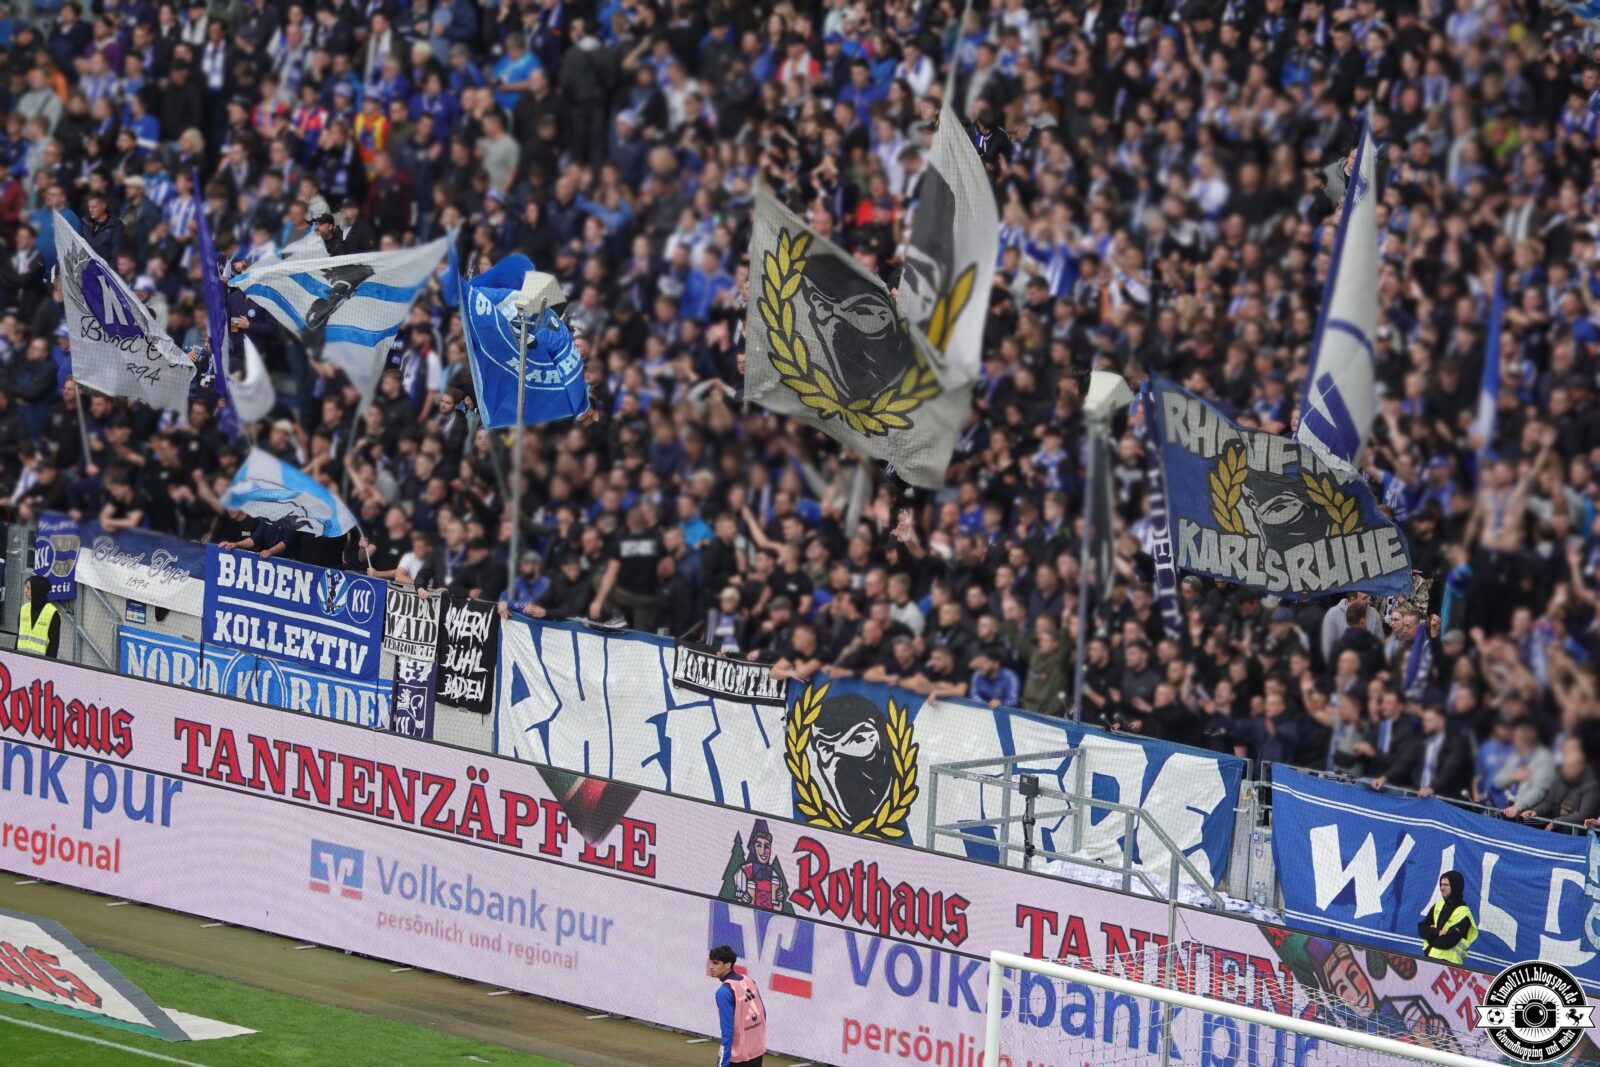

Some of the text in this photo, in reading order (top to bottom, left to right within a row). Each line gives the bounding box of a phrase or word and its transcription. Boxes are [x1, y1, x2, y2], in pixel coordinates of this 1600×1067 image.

[92, 536, 191, 583] Blood Type
[217, 552, 314, 605] BADEN
[1177, 519, 1408, 592] KARLSRUHE
[352, 589, 371, 613] KSC
[386, 613, 436, 644] WALD
[388, 590, 438, 621] ODEN
[212, 610, 368, 675] KOLLEKTIV
[384, 637, 434, 659] TERROR 747
[126, 641, 220, 695] NORD
[290, 676, 390, 731] BADEN
[437, 673, 487, 703] BADEN
[500, 617, 794, 818] RHEIN
[83, 760, 183, 829] pur
[174, 718, 657, 879] TANNENZÄPFLE
[2, 822, 120, 874] regional
[376, 855, 614, 946] Volksbank pur
[789, 836, 971, 947] Rothaus
[1309, 824, 1596, 967] WILD
[376, 910, 579, 971] persönlich und regional
[1016, 903, 1322, 1024] TANNEN
